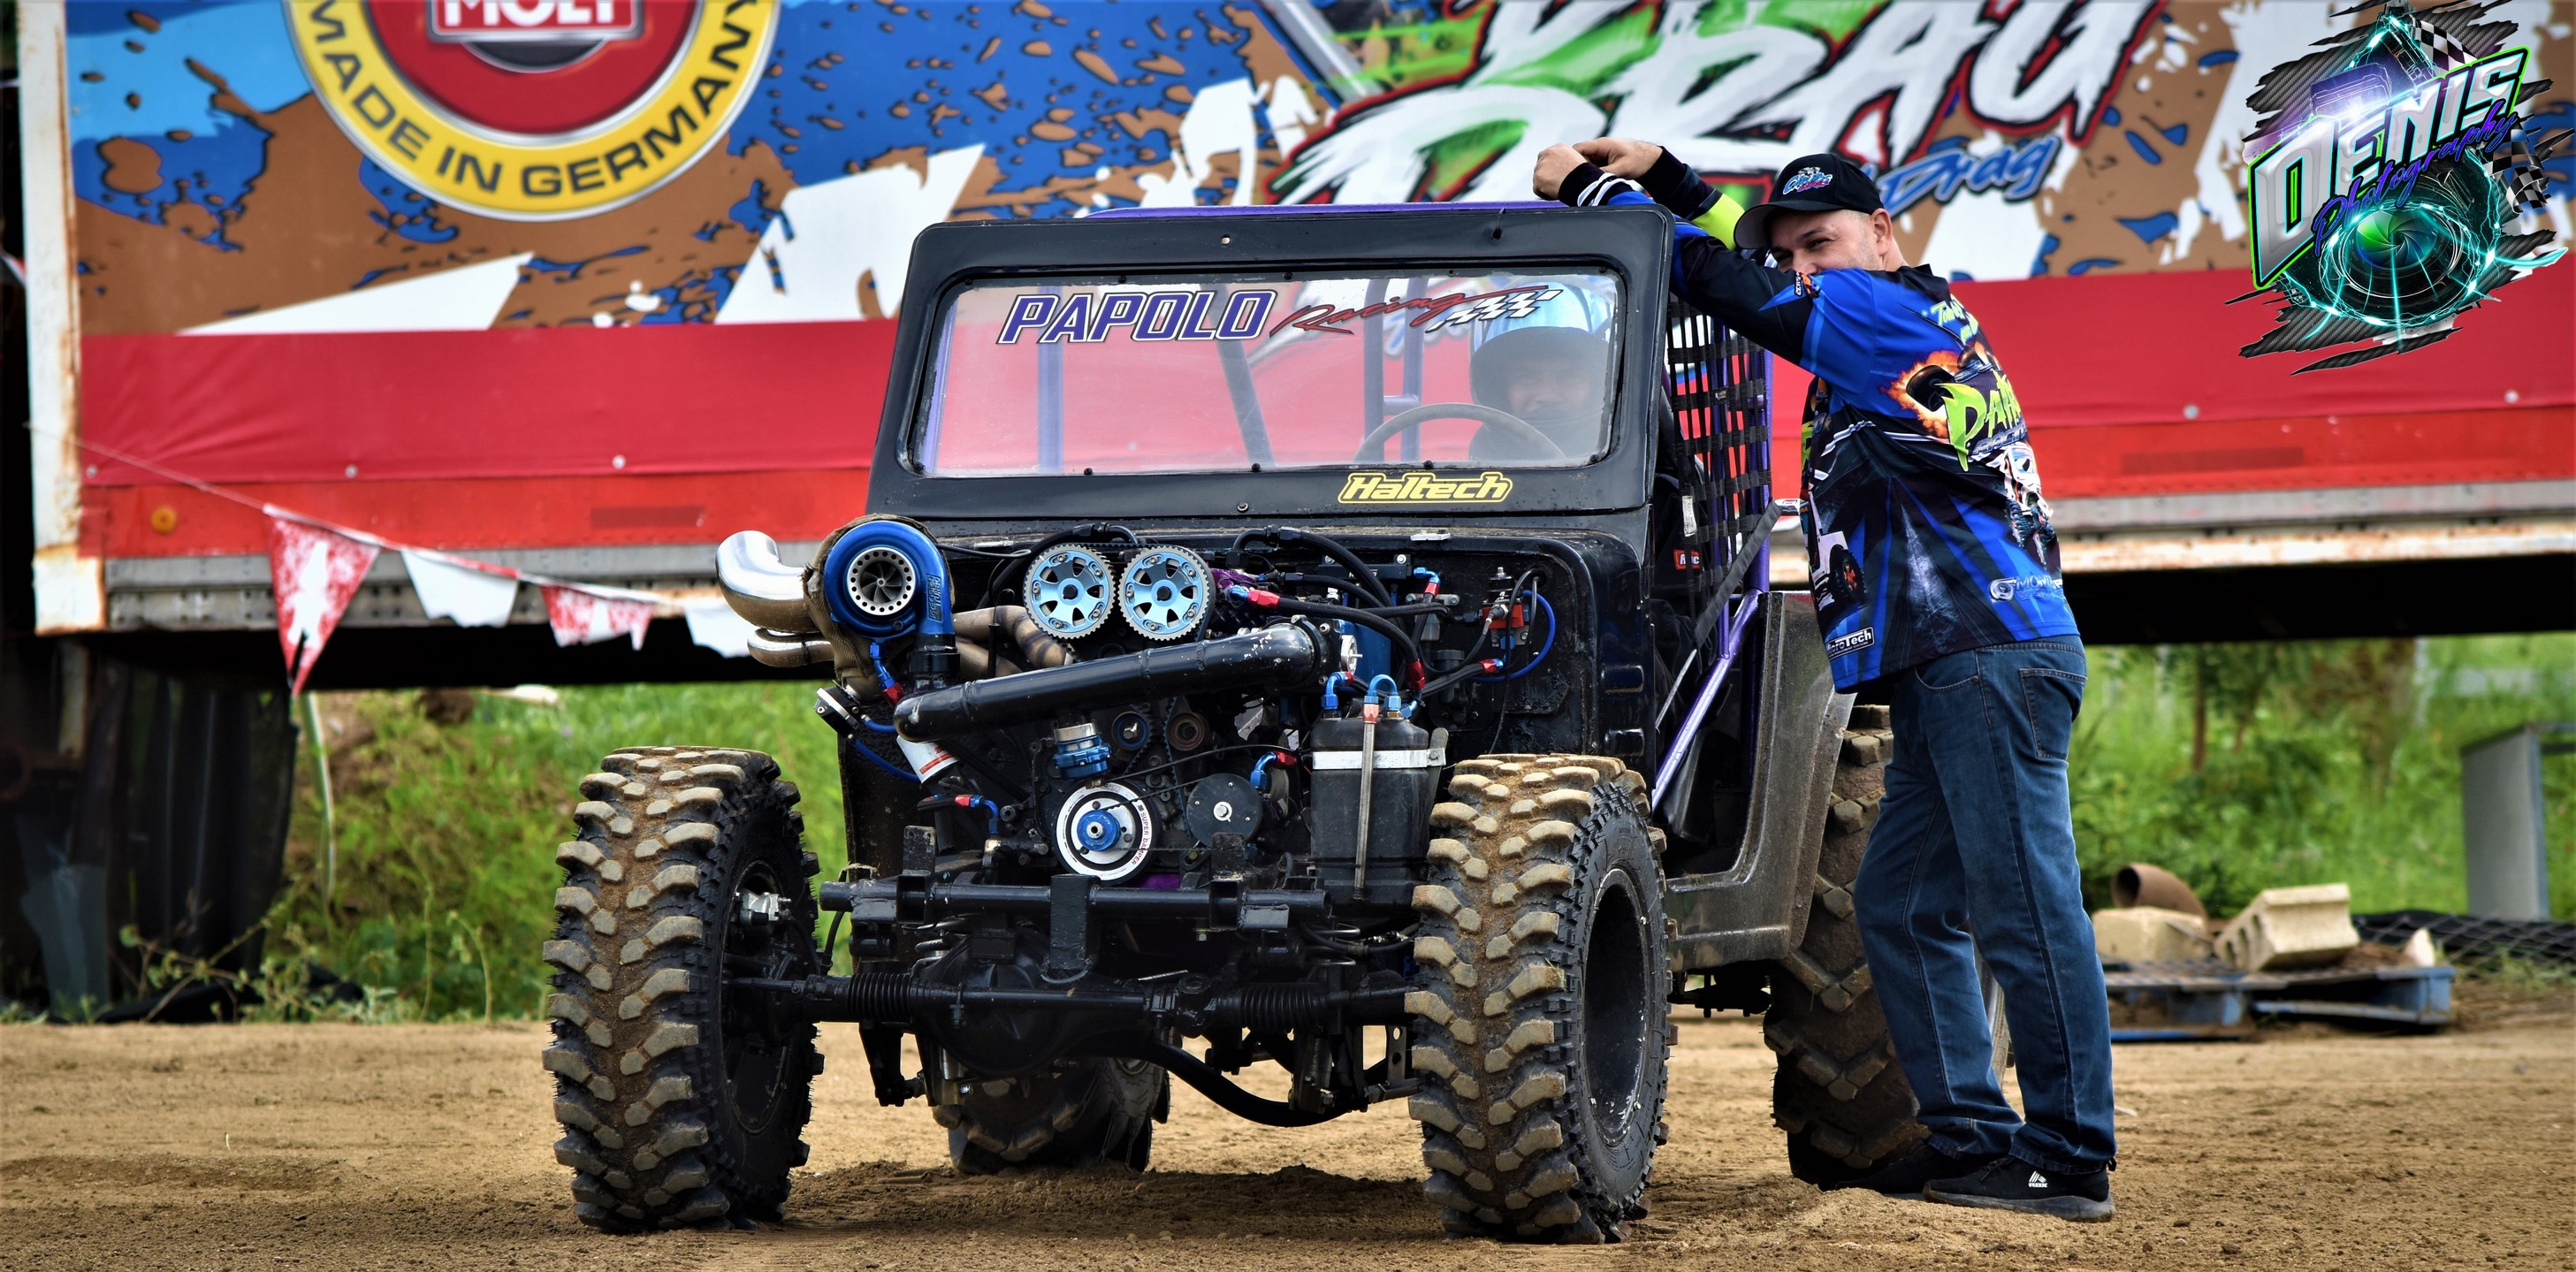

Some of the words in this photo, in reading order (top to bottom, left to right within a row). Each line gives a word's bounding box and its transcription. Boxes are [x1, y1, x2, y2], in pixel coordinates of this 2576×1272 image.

[310, 0, 431, 162] MADE
[437, 146, 502, 194] IN
[1878, 135, 2061, 219] Drag
[996, 290, 1277, 344] PAPOLO
[1269, 285, 1549, 338] Racing
[1339, 474, 1512, 502] Haltech
[1140, 811, 1149, 835] SUPER
